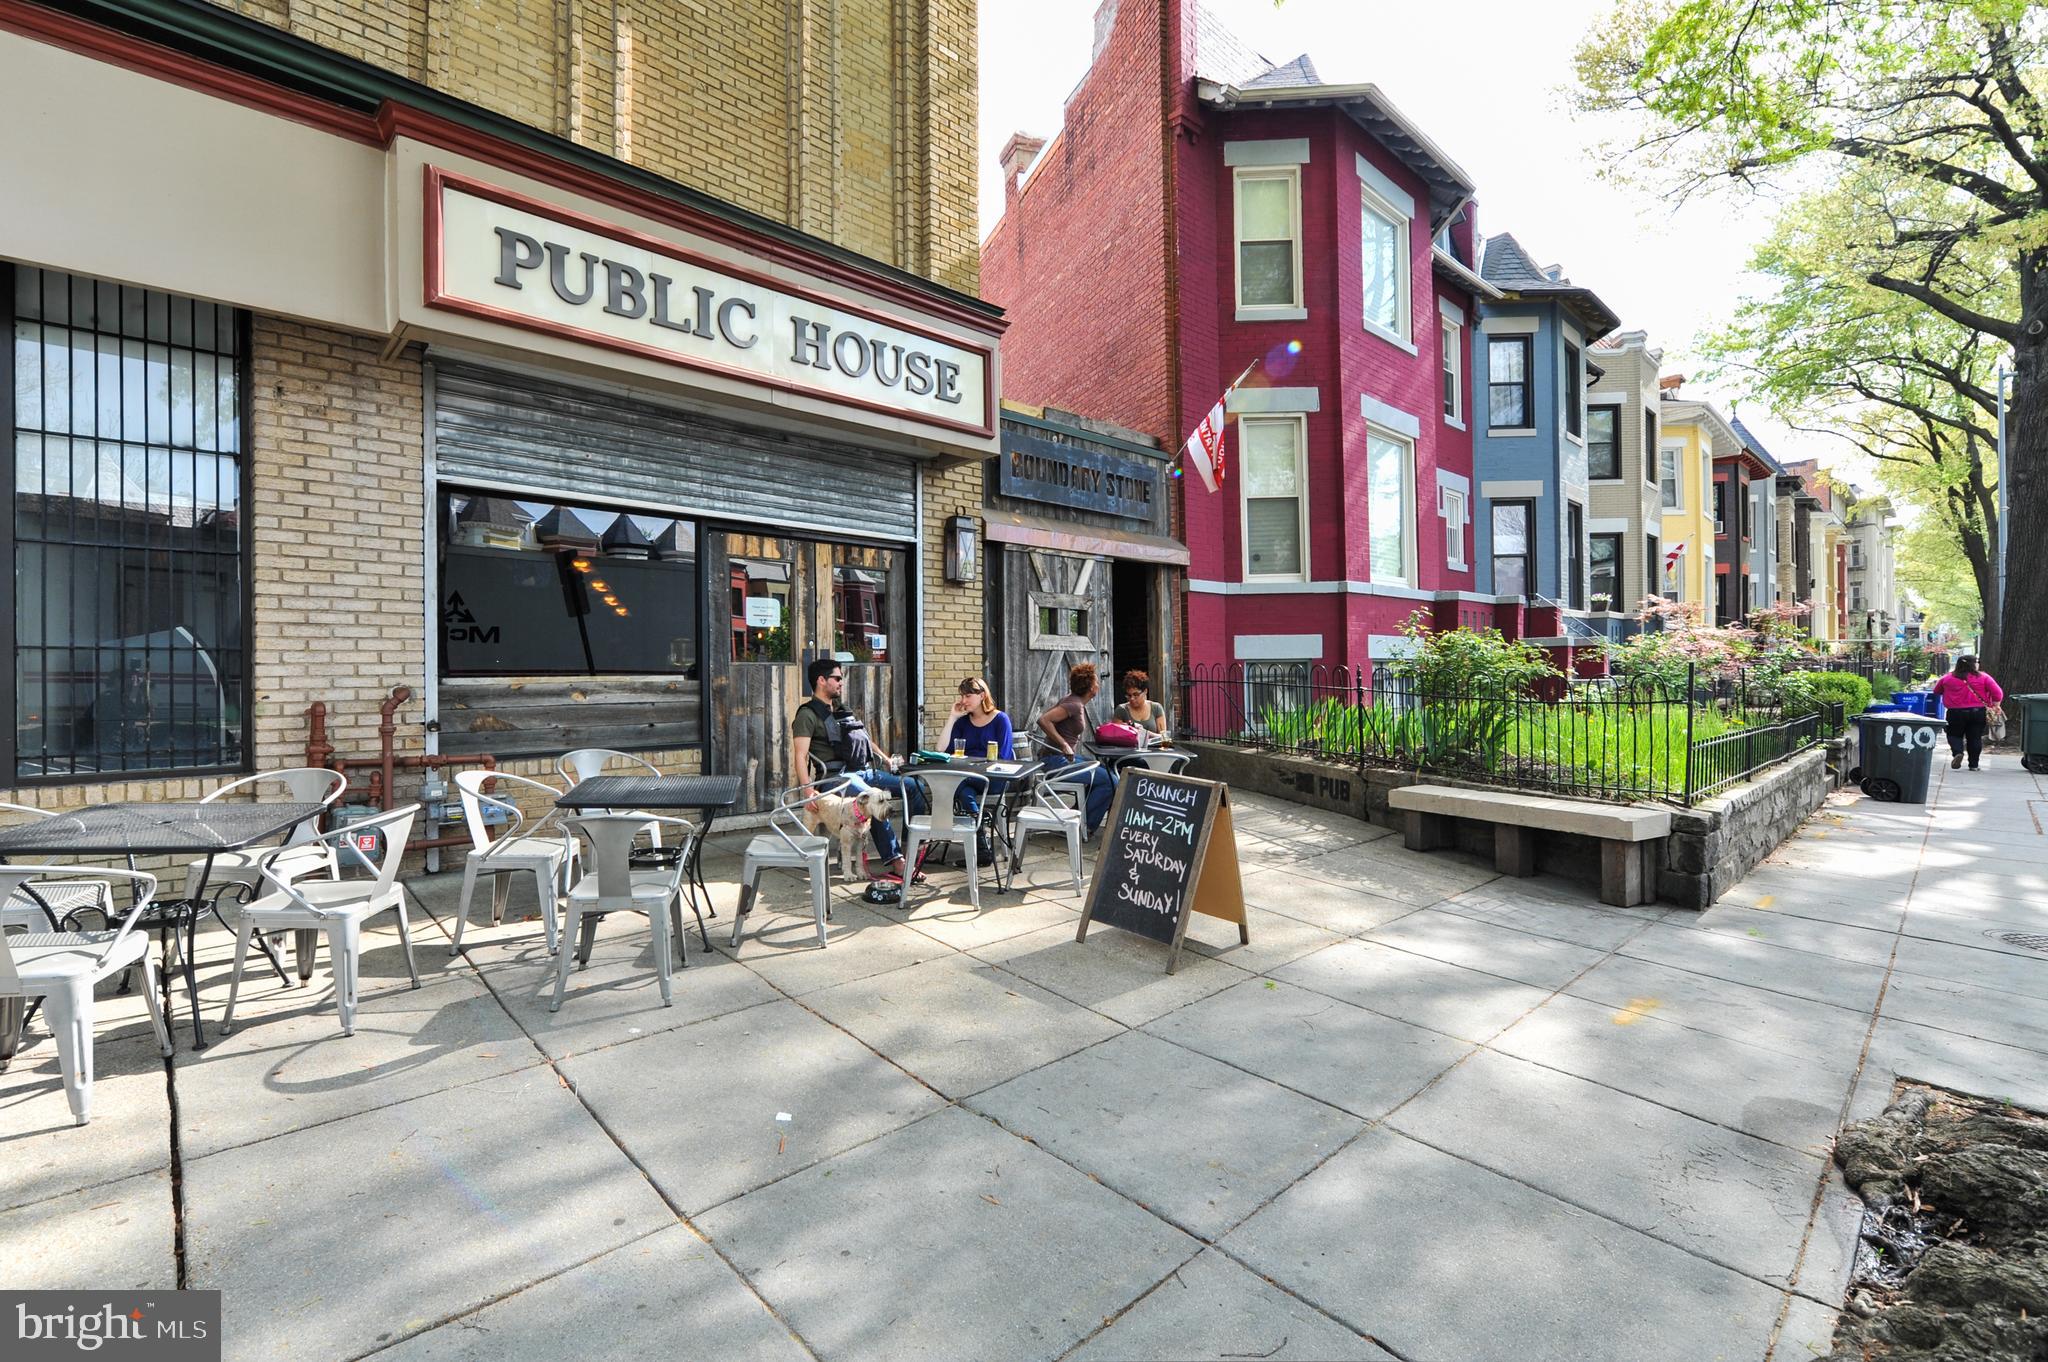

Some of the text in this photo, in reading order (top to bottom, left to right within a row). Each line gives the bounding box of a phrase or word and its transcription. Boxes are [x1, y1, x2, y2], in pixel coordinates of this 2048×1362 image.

[494, 226, 963, 404] PUBLIC HOUSE
[1011, 450, 1152, 504] BOUNDARY STONE
[1136, 778, 1198, 807] BRUNCH
[1319, 776, 1351, 802] PUB
[1120, 826, 1160, 854] EVERY
[1123, 842, 1187, 883] SATURDAY
[1128, 862, 1141, 886] &
[1117, 882, 1181, 924] SUNDAY!
